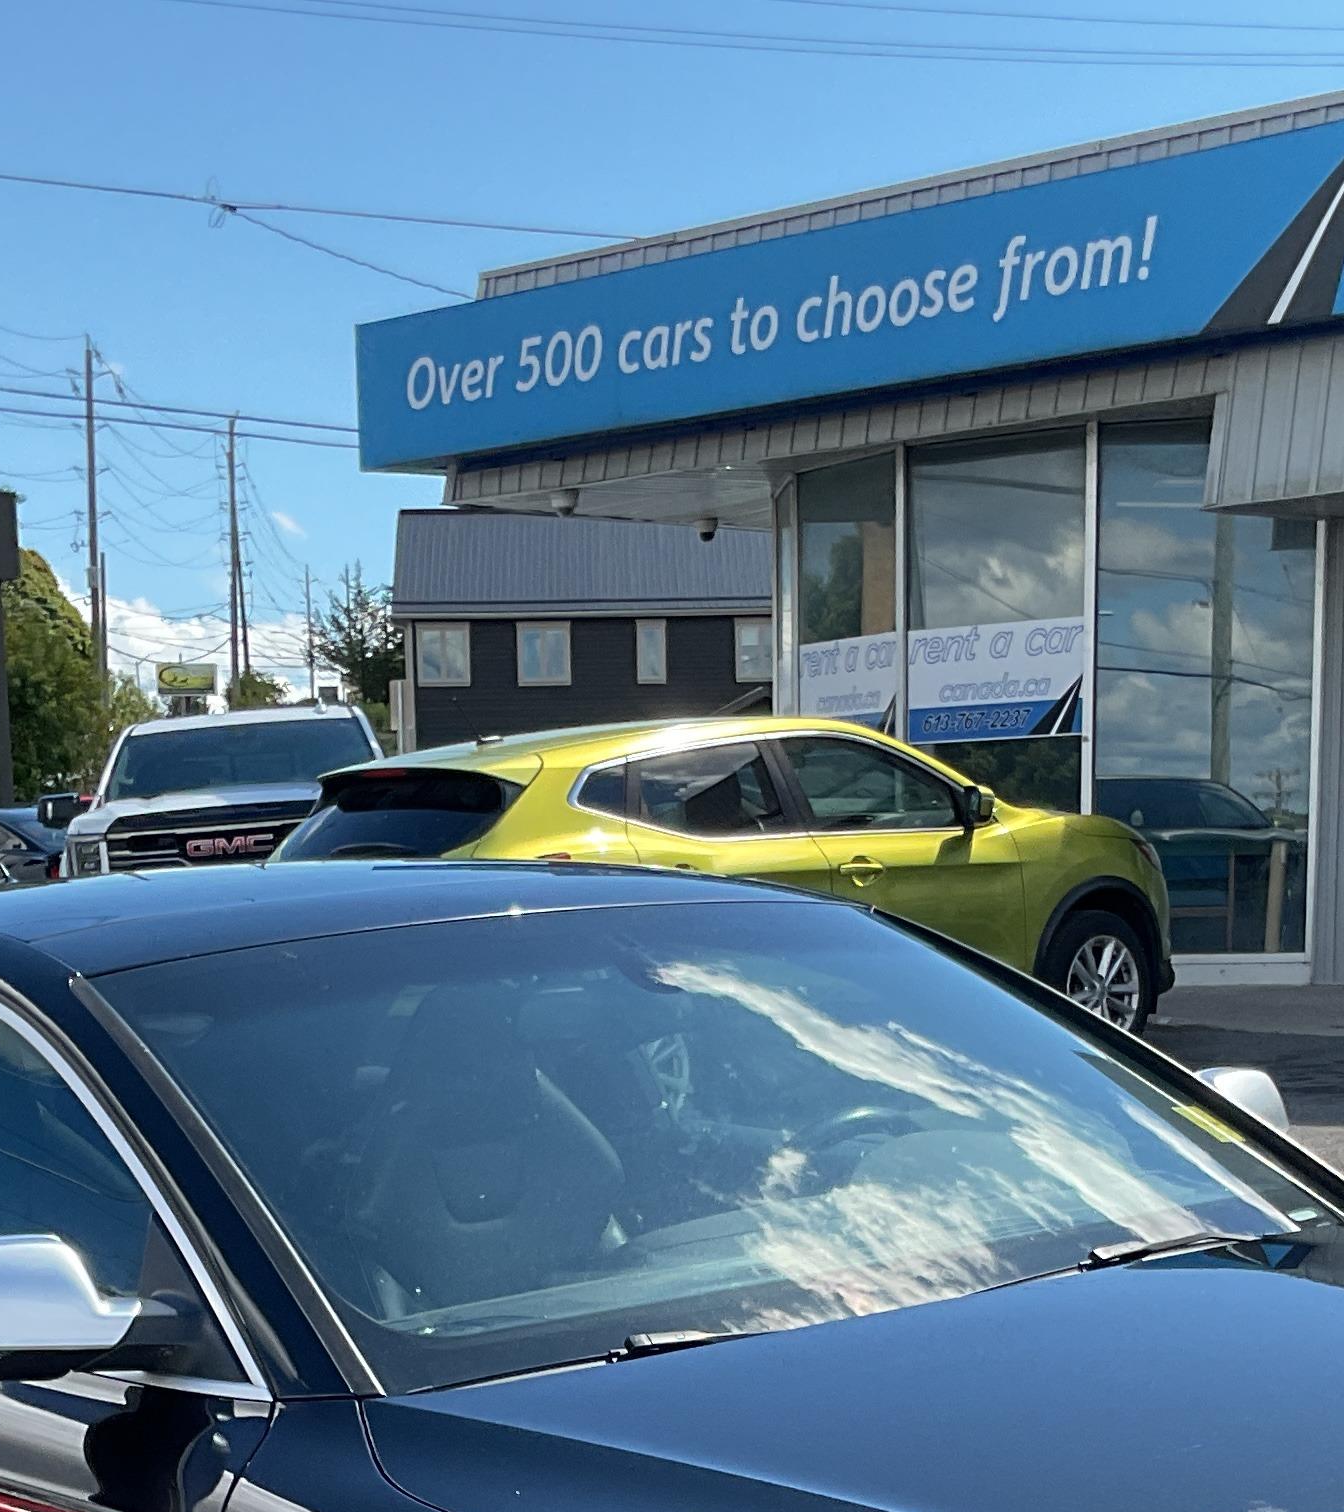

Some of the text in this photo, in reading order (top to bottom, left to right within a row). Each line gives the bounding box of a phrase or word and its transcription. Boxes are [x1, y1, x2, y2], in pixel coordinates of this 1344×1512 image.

[406, 214, 1158, 411] Over 500 cars to choose from!
[909, 624, 1084, 665] rent a car
[922, 708, 1032, 734] 613-767-2237
[186, 834, 274, 857] GMC
